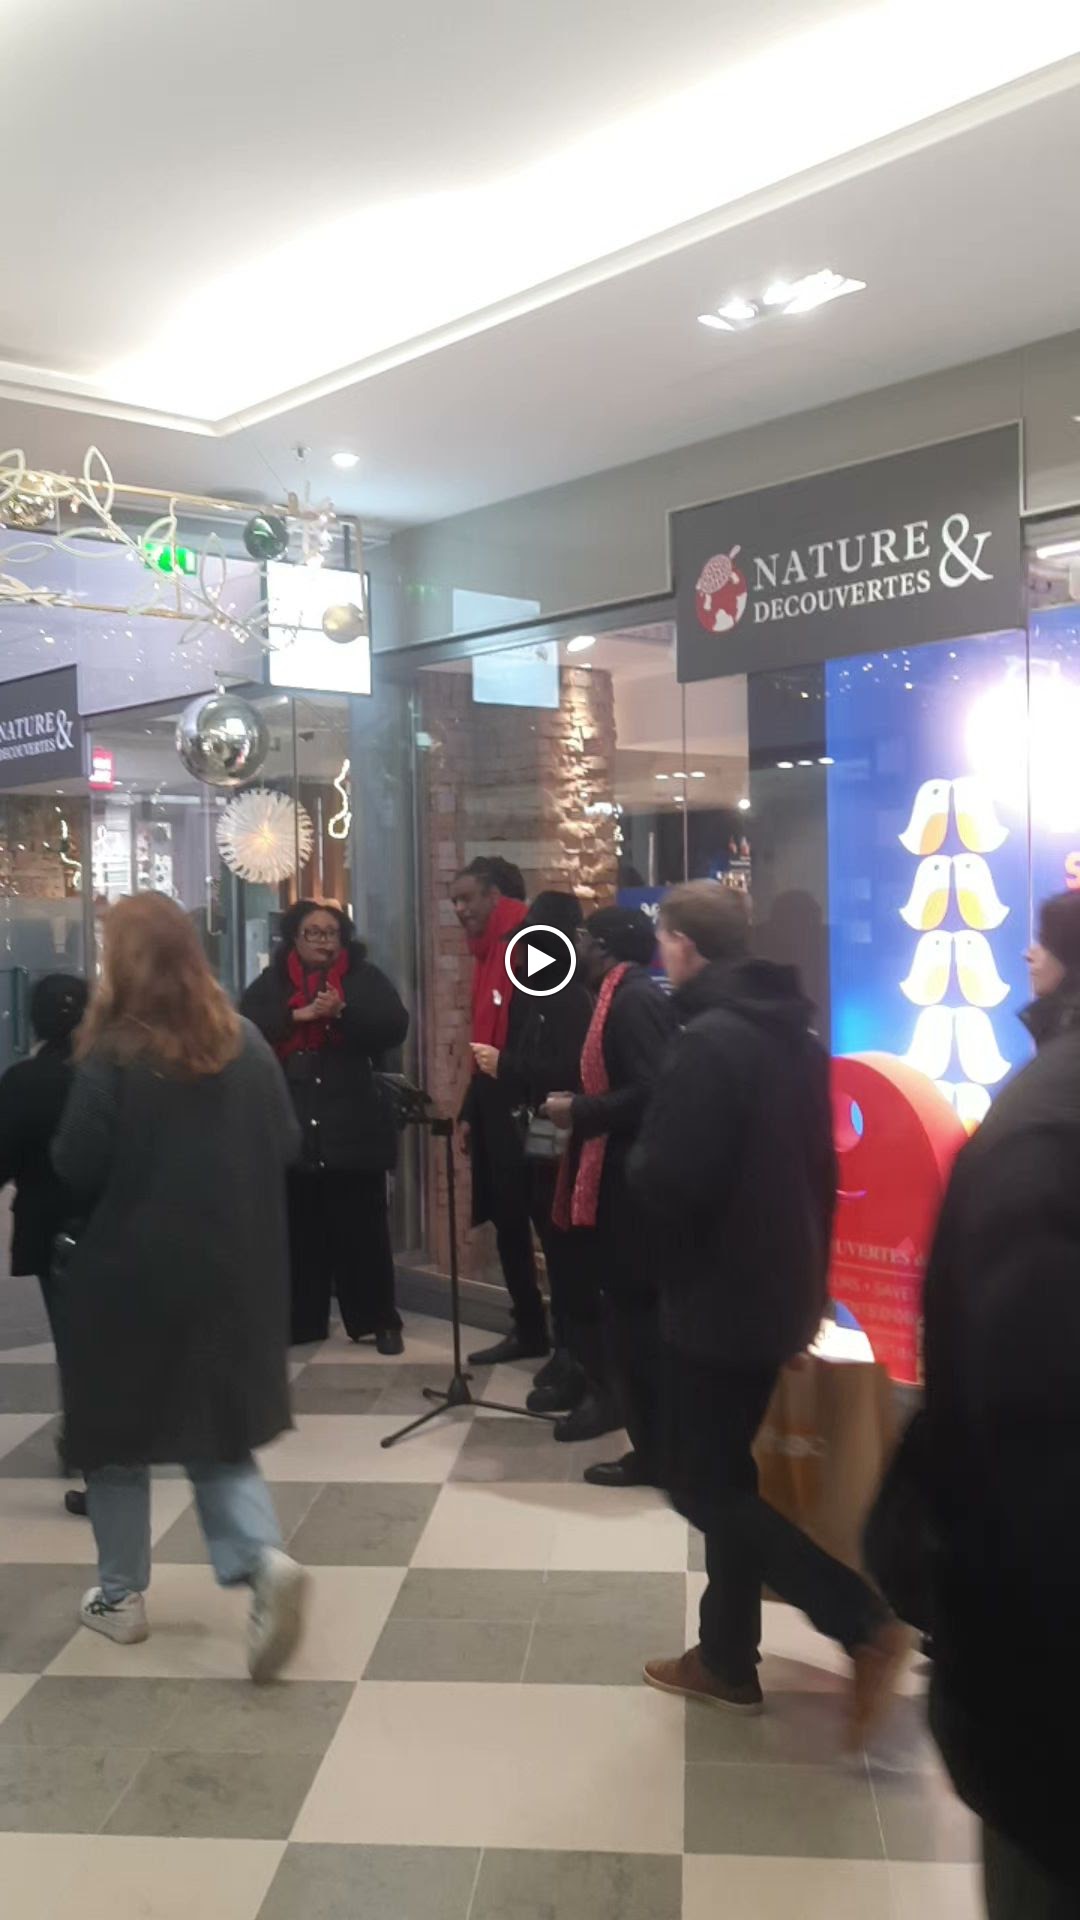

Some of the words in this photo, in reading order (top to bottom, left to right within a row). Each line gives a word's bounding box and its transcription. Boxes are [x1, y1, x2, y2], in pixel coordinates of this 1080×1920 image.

[753, 520, 931, 591] NATURE
[938, 512, 994, 588] &
[753, 569, 931, 624] DECOUVERTES
[56, 709, 75, 750] &
